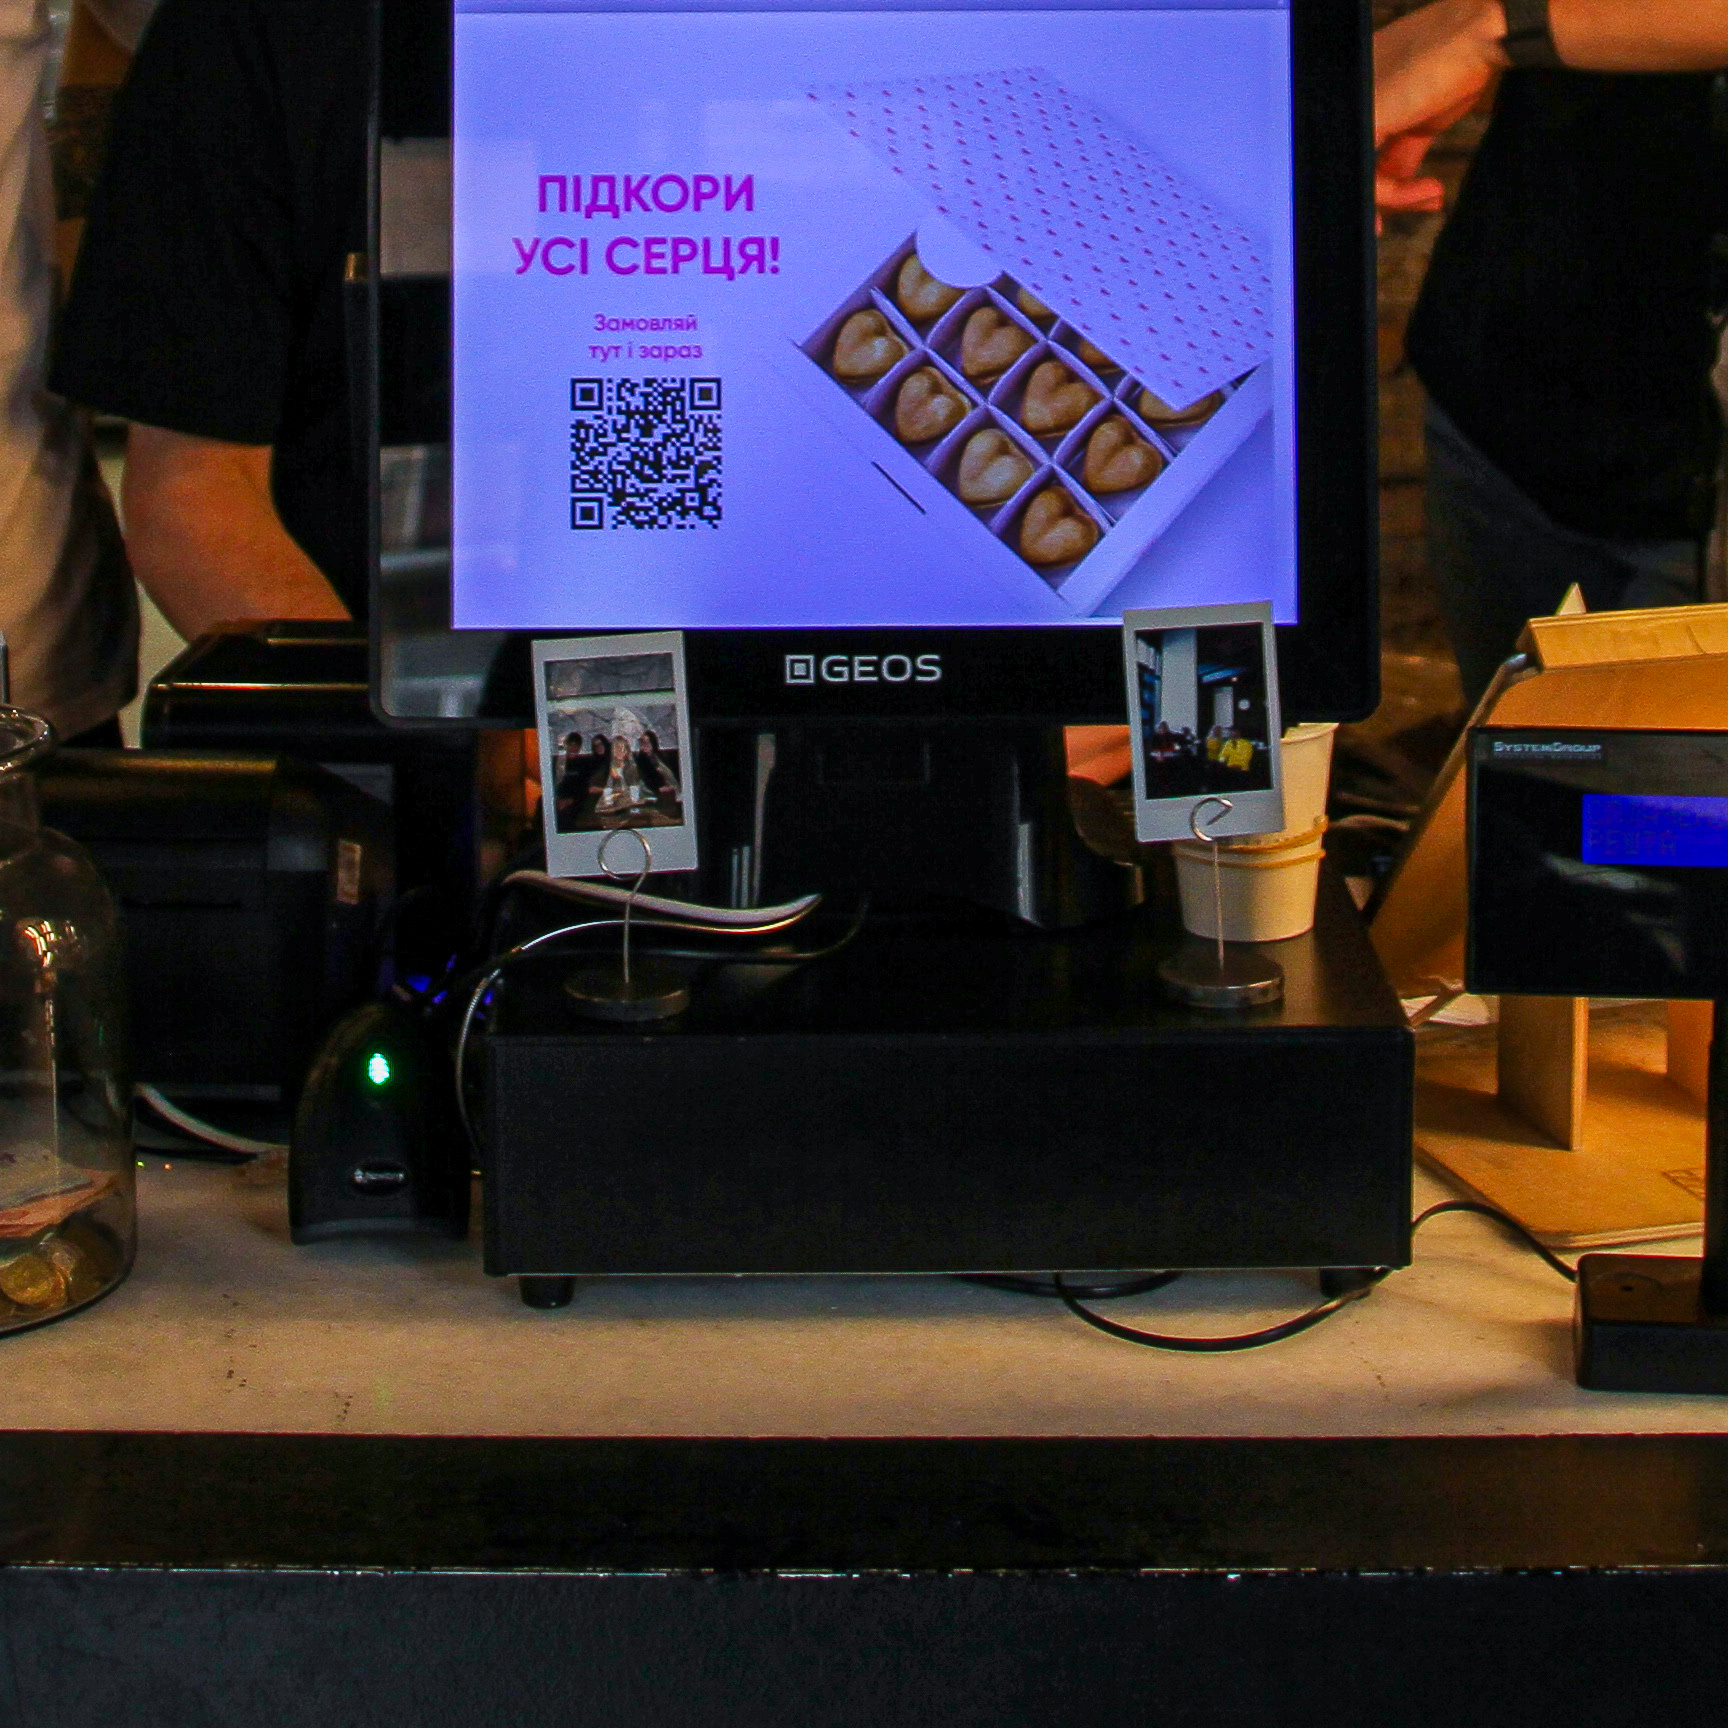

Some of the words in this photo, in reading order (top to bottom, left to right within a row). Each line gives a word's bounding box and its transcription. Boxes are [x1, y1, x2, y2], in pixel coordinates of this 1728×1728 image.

[538, 174, 754, 219] ПІДКОРИ
[512, 237, 589, 275] УСІ
[605, 236, 780, 281] СЕРЦЯ!
[594, 313, 698, 332] Замовляй
[589, 344, 622, 362] тут
[638, 344, 703, 362] зараз
[821, 654, 943, 682] GEOS
